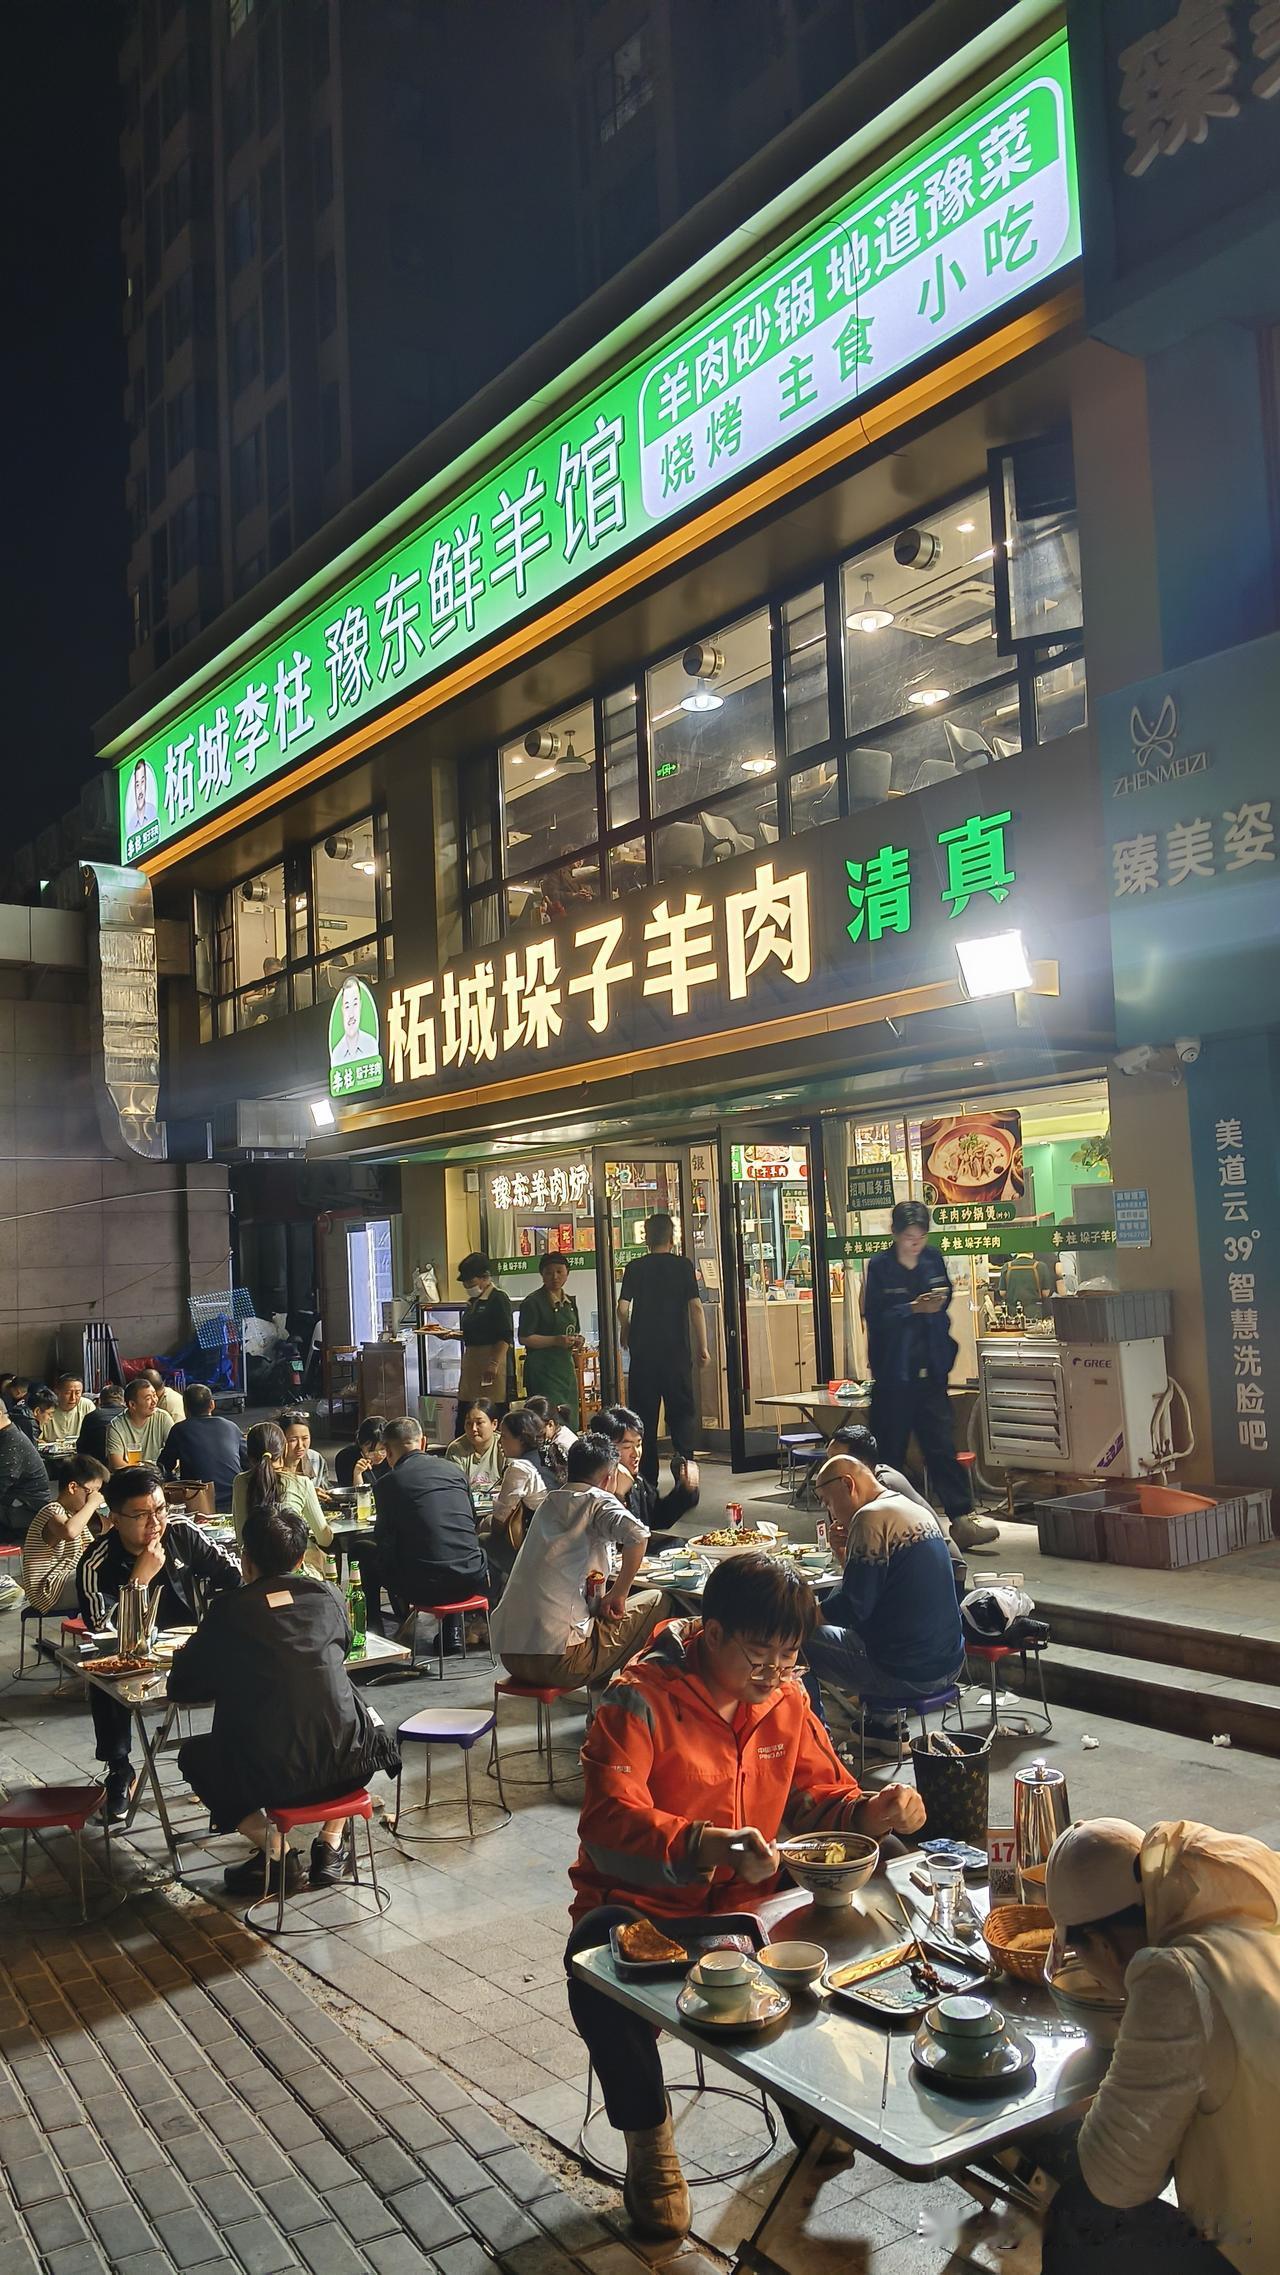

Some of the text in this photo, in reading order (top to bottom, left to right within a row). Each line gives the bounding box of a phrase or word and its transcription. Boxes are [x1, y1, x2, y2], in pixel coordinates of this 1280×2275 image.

[655, 106, 1031, 424] 羊肉砂锅 地道豫菜
[660, 201, 1039, 499] 烧烤 主食 小吃
[163, 414, 627, 826] 柘城李柱 豫东鲜羊馆
[1112, 752, 1208, 798] ZHENMEIZI
[1112, 801, 1276, 898] 臻美姿
[388, 809, 1016, 1084] 柘城垛子羊肉 清真
[941, 1234, 1001, 1251] 李柱 垛子羊肉
[1052, 1231, 1078, 1247] 李柱
[1084, 1359, 1112, 1368] GREE
[819, 1525, 824, 1537] 6
[991, 1842, 1015, 1863] 17
